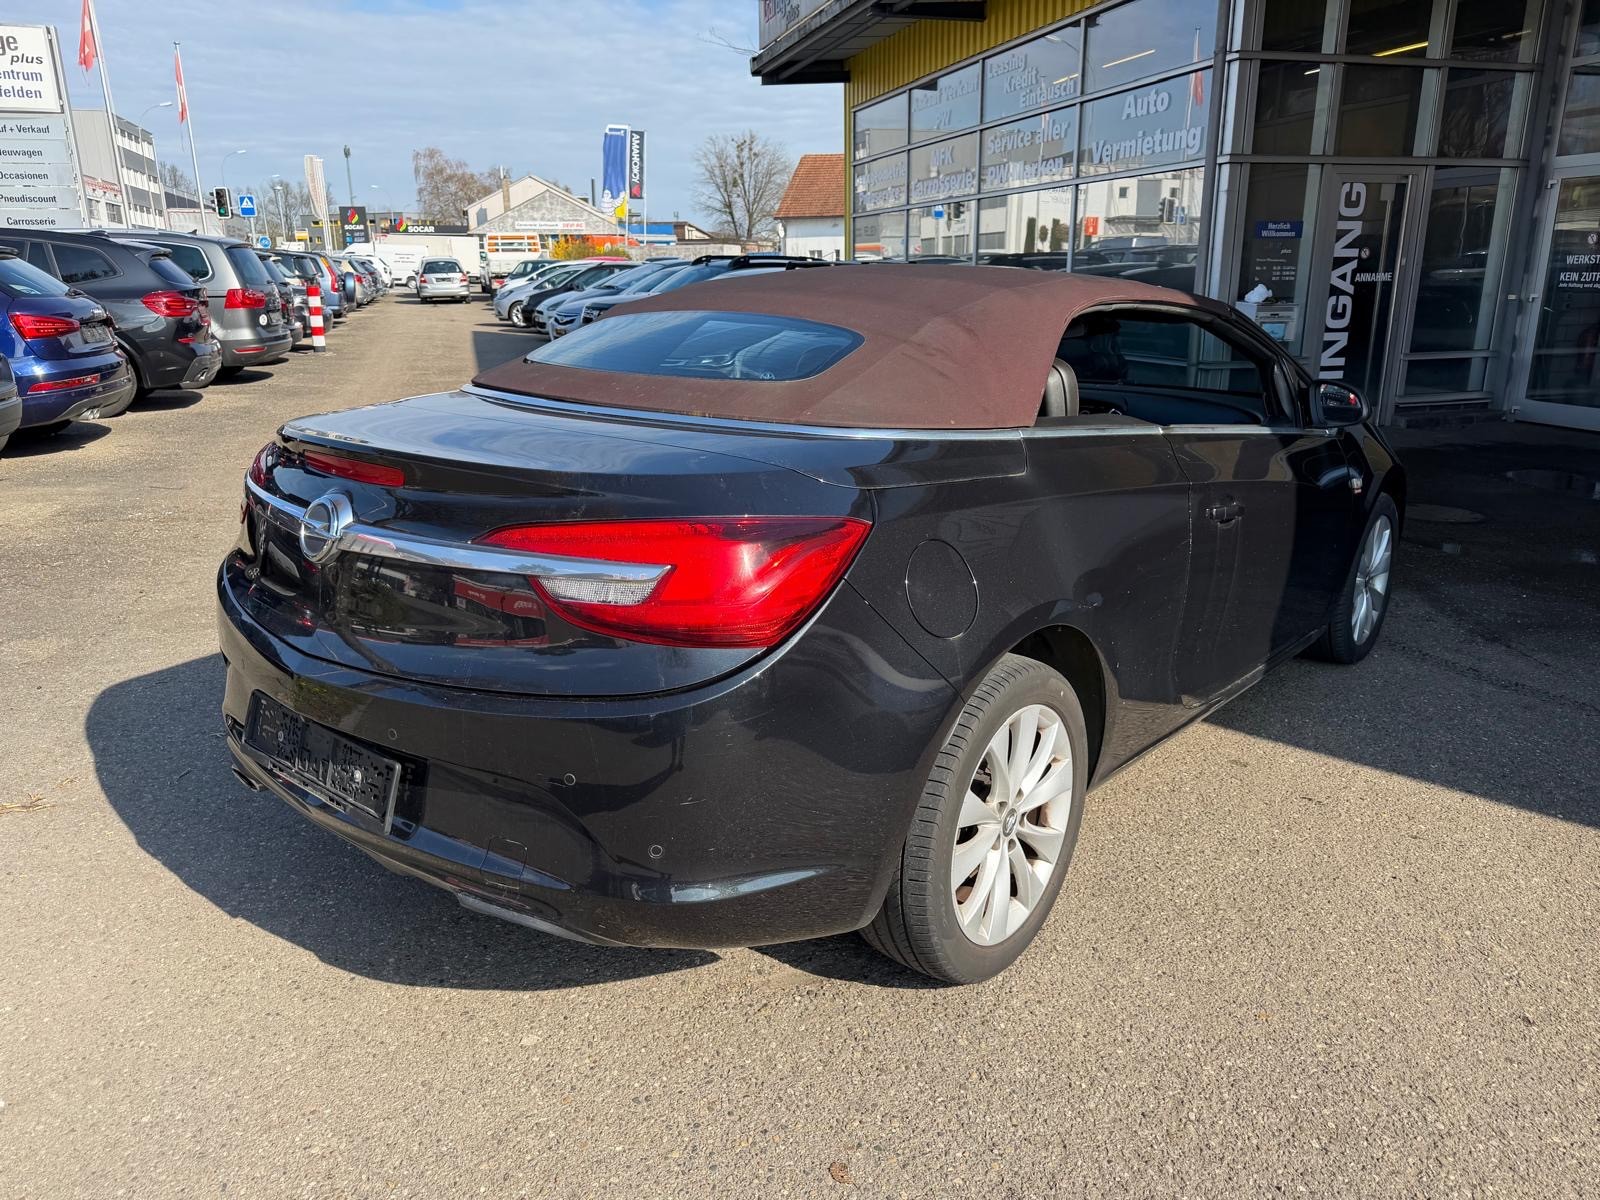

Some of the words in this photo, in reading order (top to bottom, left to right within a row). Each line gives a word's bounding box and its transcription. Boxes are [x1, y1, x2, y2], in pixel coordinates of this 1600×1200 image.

[10, 53, 44, 65] plus
[988, 54, 1028, 77] Leasing
[0, 69, 43, 82] ntrum
[945, 74, 979, 101] Verkauf
[1004, 67, 1039, 93] Kredit
[1020, 80, 1075, 108] Eintausch
[1122, 88, 1171, 120] Auto
[16, 124, 50, 134] Verkauf
[988, 128, 1033, 154] Service
[1036, 120, 1070, 144] aller
[1093, 126, 1204, 164] Vermietung
[912, 169, 975, 199] Carrosserie
[7, 216, 56, 226] Carrosserie
[407, 225, 435, 233] SOCAR
[1318, 182, 1367, 380] INGANG
[1355, 272, 1393, 282] ANNAHME
[1560, 272, 1579, 281] KEIN
